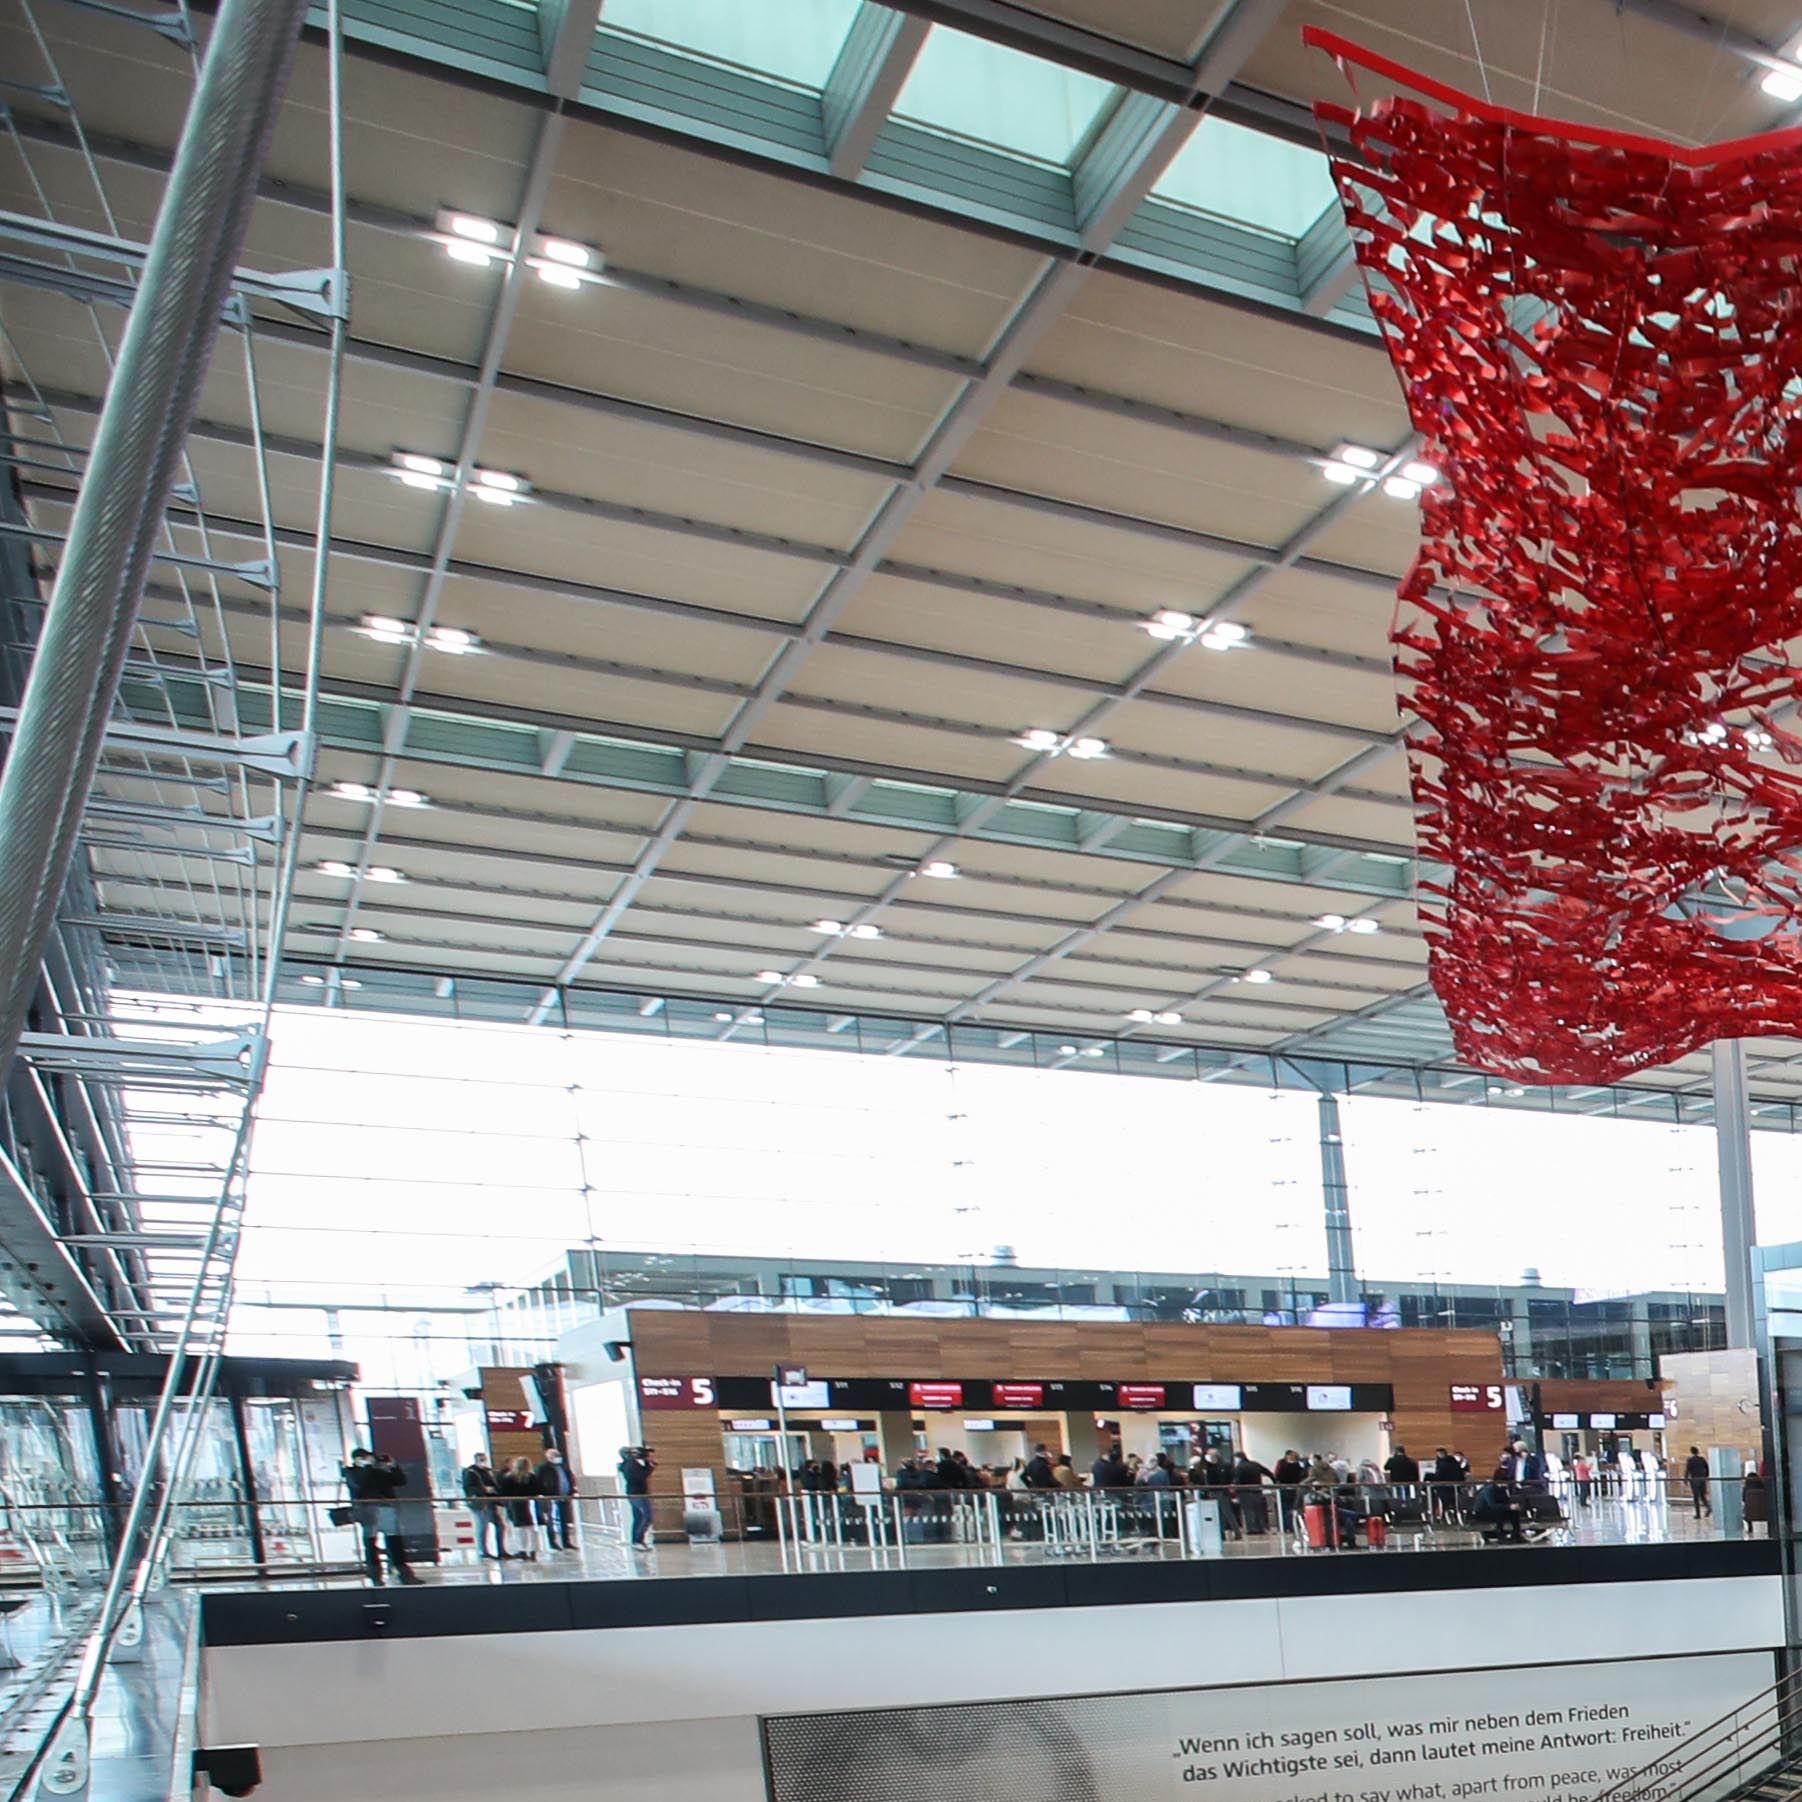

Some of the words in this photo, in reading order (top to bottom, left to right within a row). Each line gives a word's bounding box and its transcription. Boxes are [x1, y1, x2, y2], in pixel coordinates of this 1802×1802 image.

[691, 1378, 714, 1405] 5
[1486, 1386, 1502, 1408] 5
[1245, 1731, 1275, 1750] ich
[1280, 1728, 1338, 1750] sagen
[1344, 1722, 1382, 1742] soll,
[1387, 1721, 1423, 1738] was
[1430, 1717, 1459, 1735] mir
[1465, 1712, 1520, 1732] neben
[1525, 1710, 1562, 1728] dem
[1568, 1703, 1630, 1724] Frieden
[1182, 1765, 1218, 1783] das
[1223, 1757, 1328, 1780] Wichtigste
[1333, 1752, 1364, 1770] sei,
[1369, 1748, 1416, 1766] dann
[1422, 1740, 1476, 1761] lautet
[1481, 1737, 1535, 1757] meine
[1540, 1730, 1617, 1751] Antwort:
[1396, 1782, 1446, 1802] what,
[1451, 1777, 1498, 1800] apart
[1503, 1772, 1545, 1793] from
[1550, 1769, 1601, 1789] peace,
[1605, 1763, 1637, 1781] was
[1642, 1758, 1684, 1777] most
